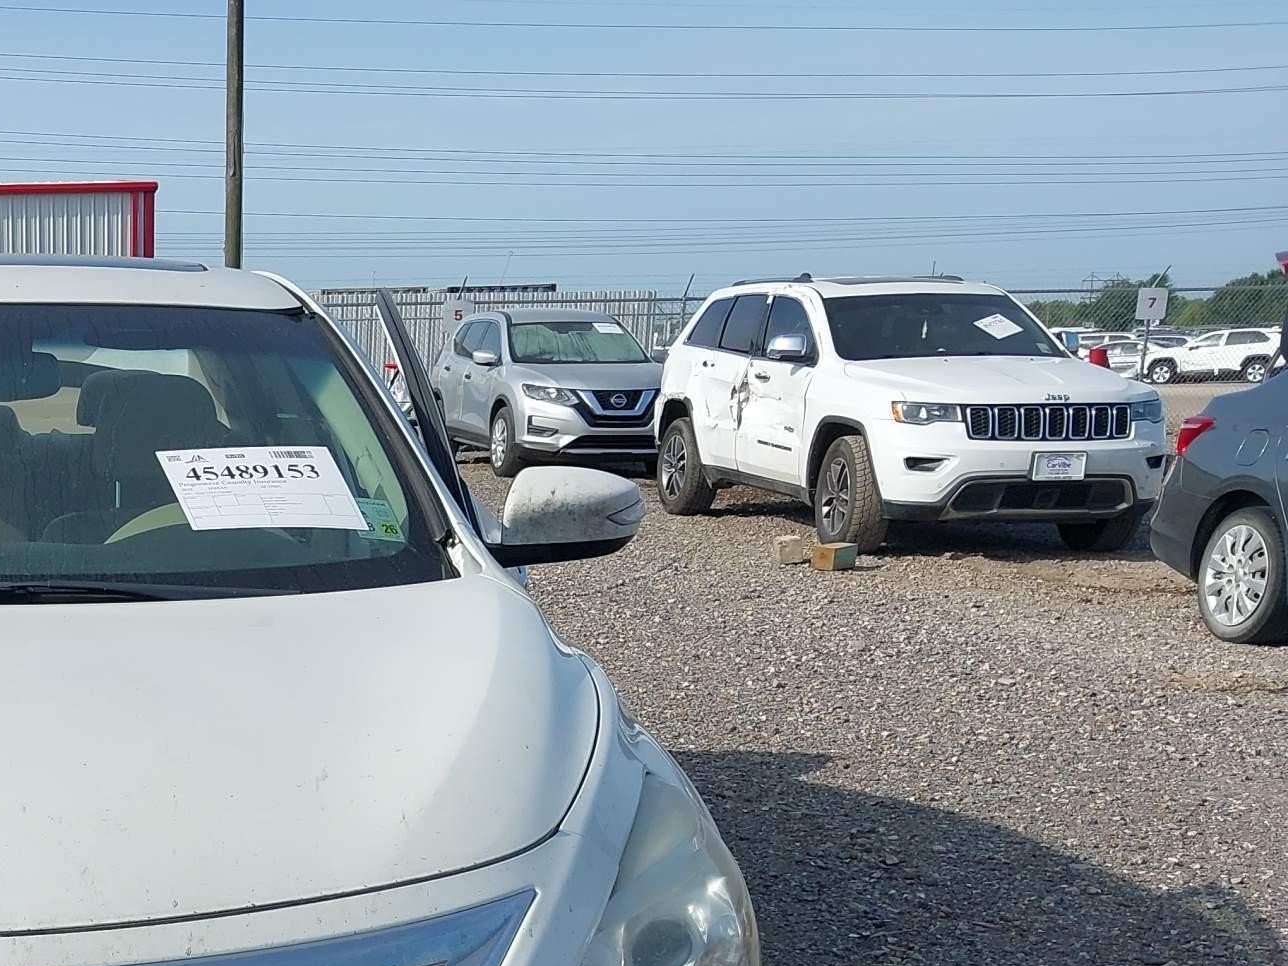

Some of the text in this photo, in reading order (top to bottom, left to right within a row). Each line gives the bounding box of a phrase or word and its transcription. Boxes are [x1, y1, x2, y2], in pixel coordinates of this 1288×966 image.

[1148, 297, 1157, 308] 7
[454, 310, 463, 321] 5
[1044, 392, 1071, 402] Jeep
[186, 464, 320, 481] 45489153
[381, 523, 399, 535] 26
